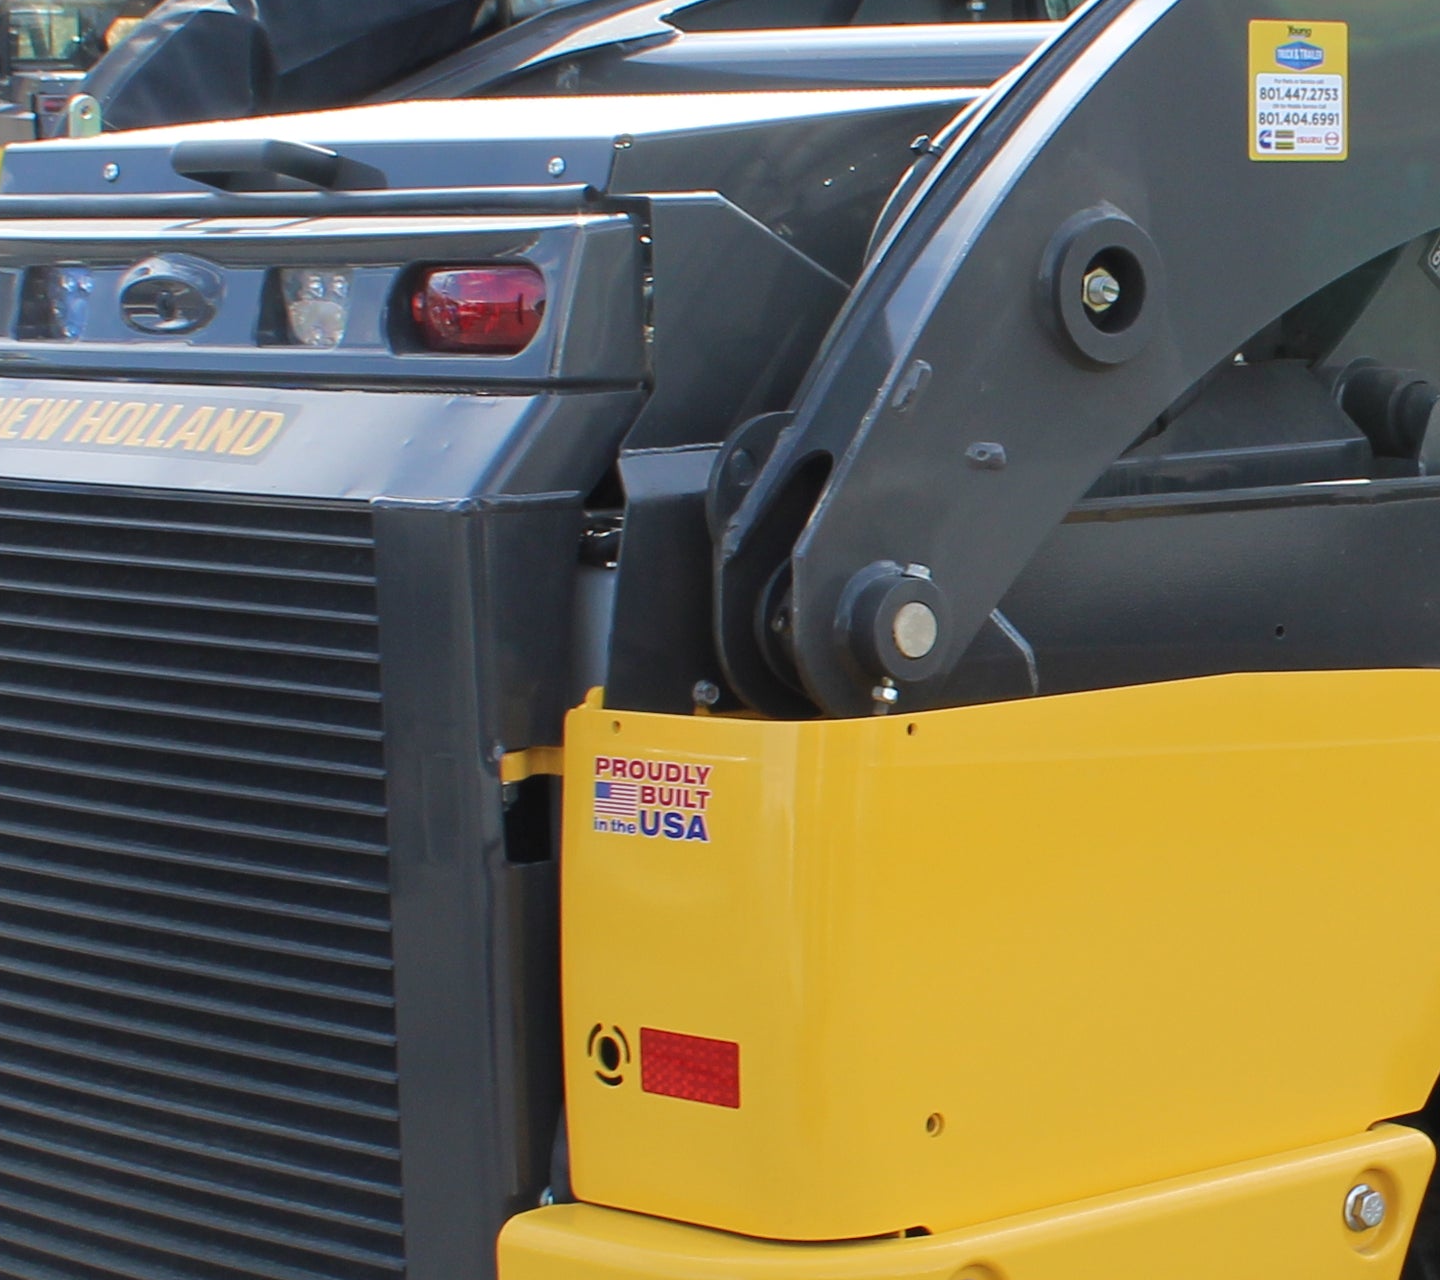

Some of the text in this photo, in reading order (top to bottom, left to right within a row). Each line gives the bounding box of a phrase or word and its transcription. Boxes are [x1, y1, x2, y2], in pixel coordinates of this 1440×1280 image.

[1259, 87, 1339, 101] 801.447.2753
[1258, 112, 1340, 126] 801.404.6991
[62, 400, 286, 457] HOLLAND
[595, 757, 711, 785] PROUDLY
[641, 785, 711, 810] BUILT
[595, 809, 709, 842] in the USA
